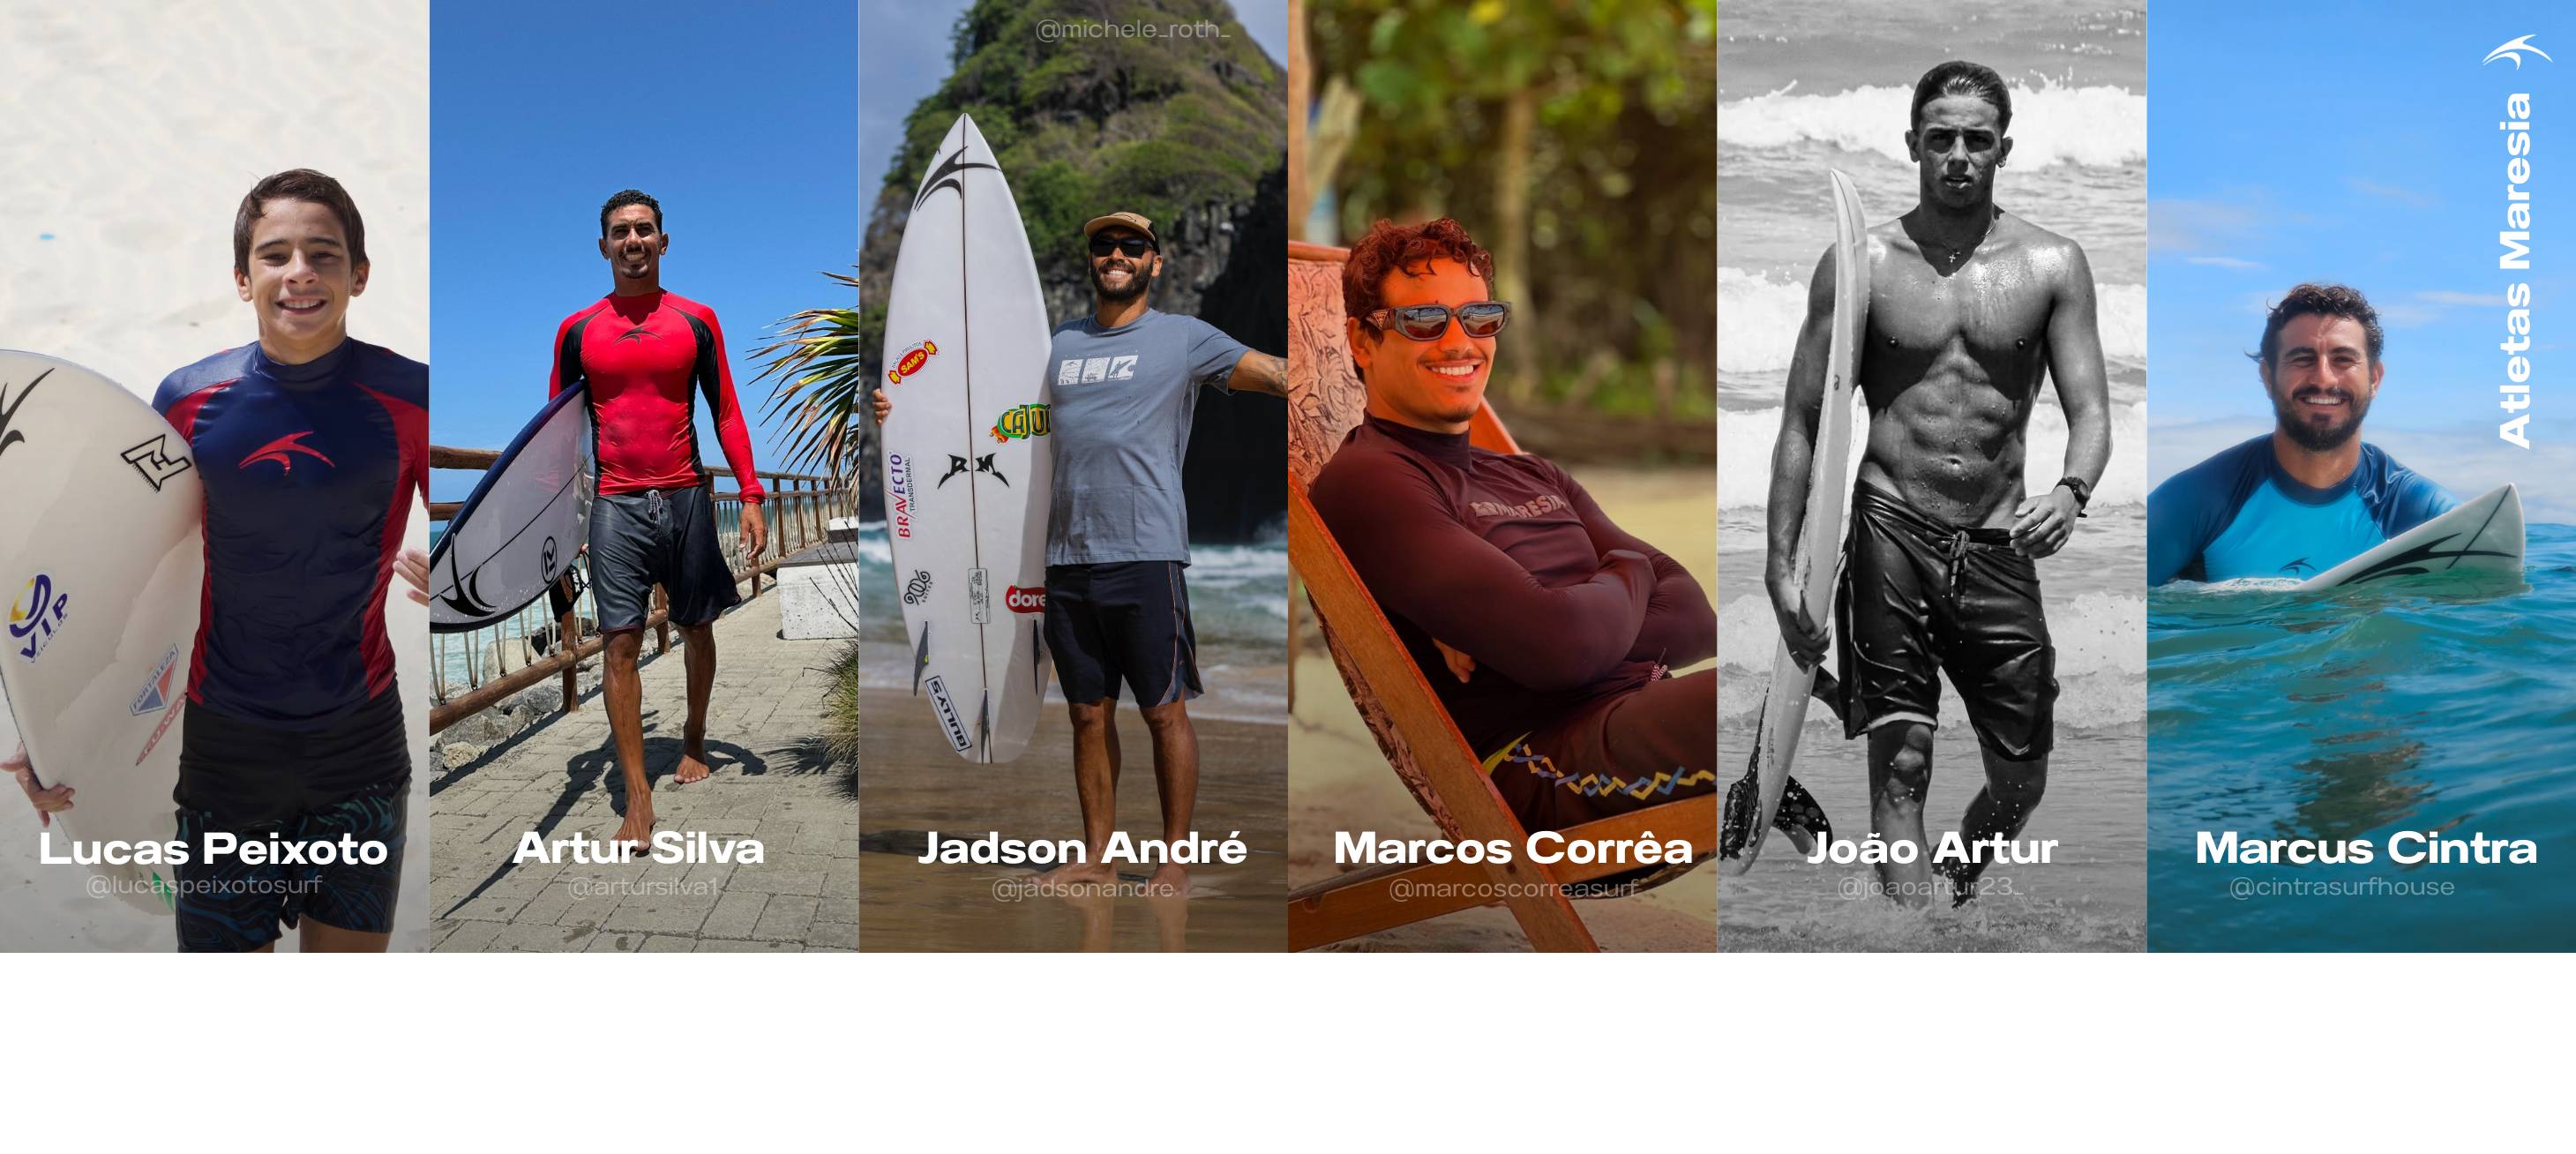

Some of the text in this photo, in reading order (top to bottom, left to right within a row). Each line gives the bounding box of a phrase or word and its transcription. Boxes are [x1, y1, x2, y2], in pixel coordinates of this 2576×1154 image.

[901, 352, 925, 373] SAM'S
[886, 453, 916, 538] BRAVECTO
[904, 457, 916, 513] TRANSDERMAL
[20, 593, 68, 658] VIP
[932, 681, 967, 747] BULLY'S
